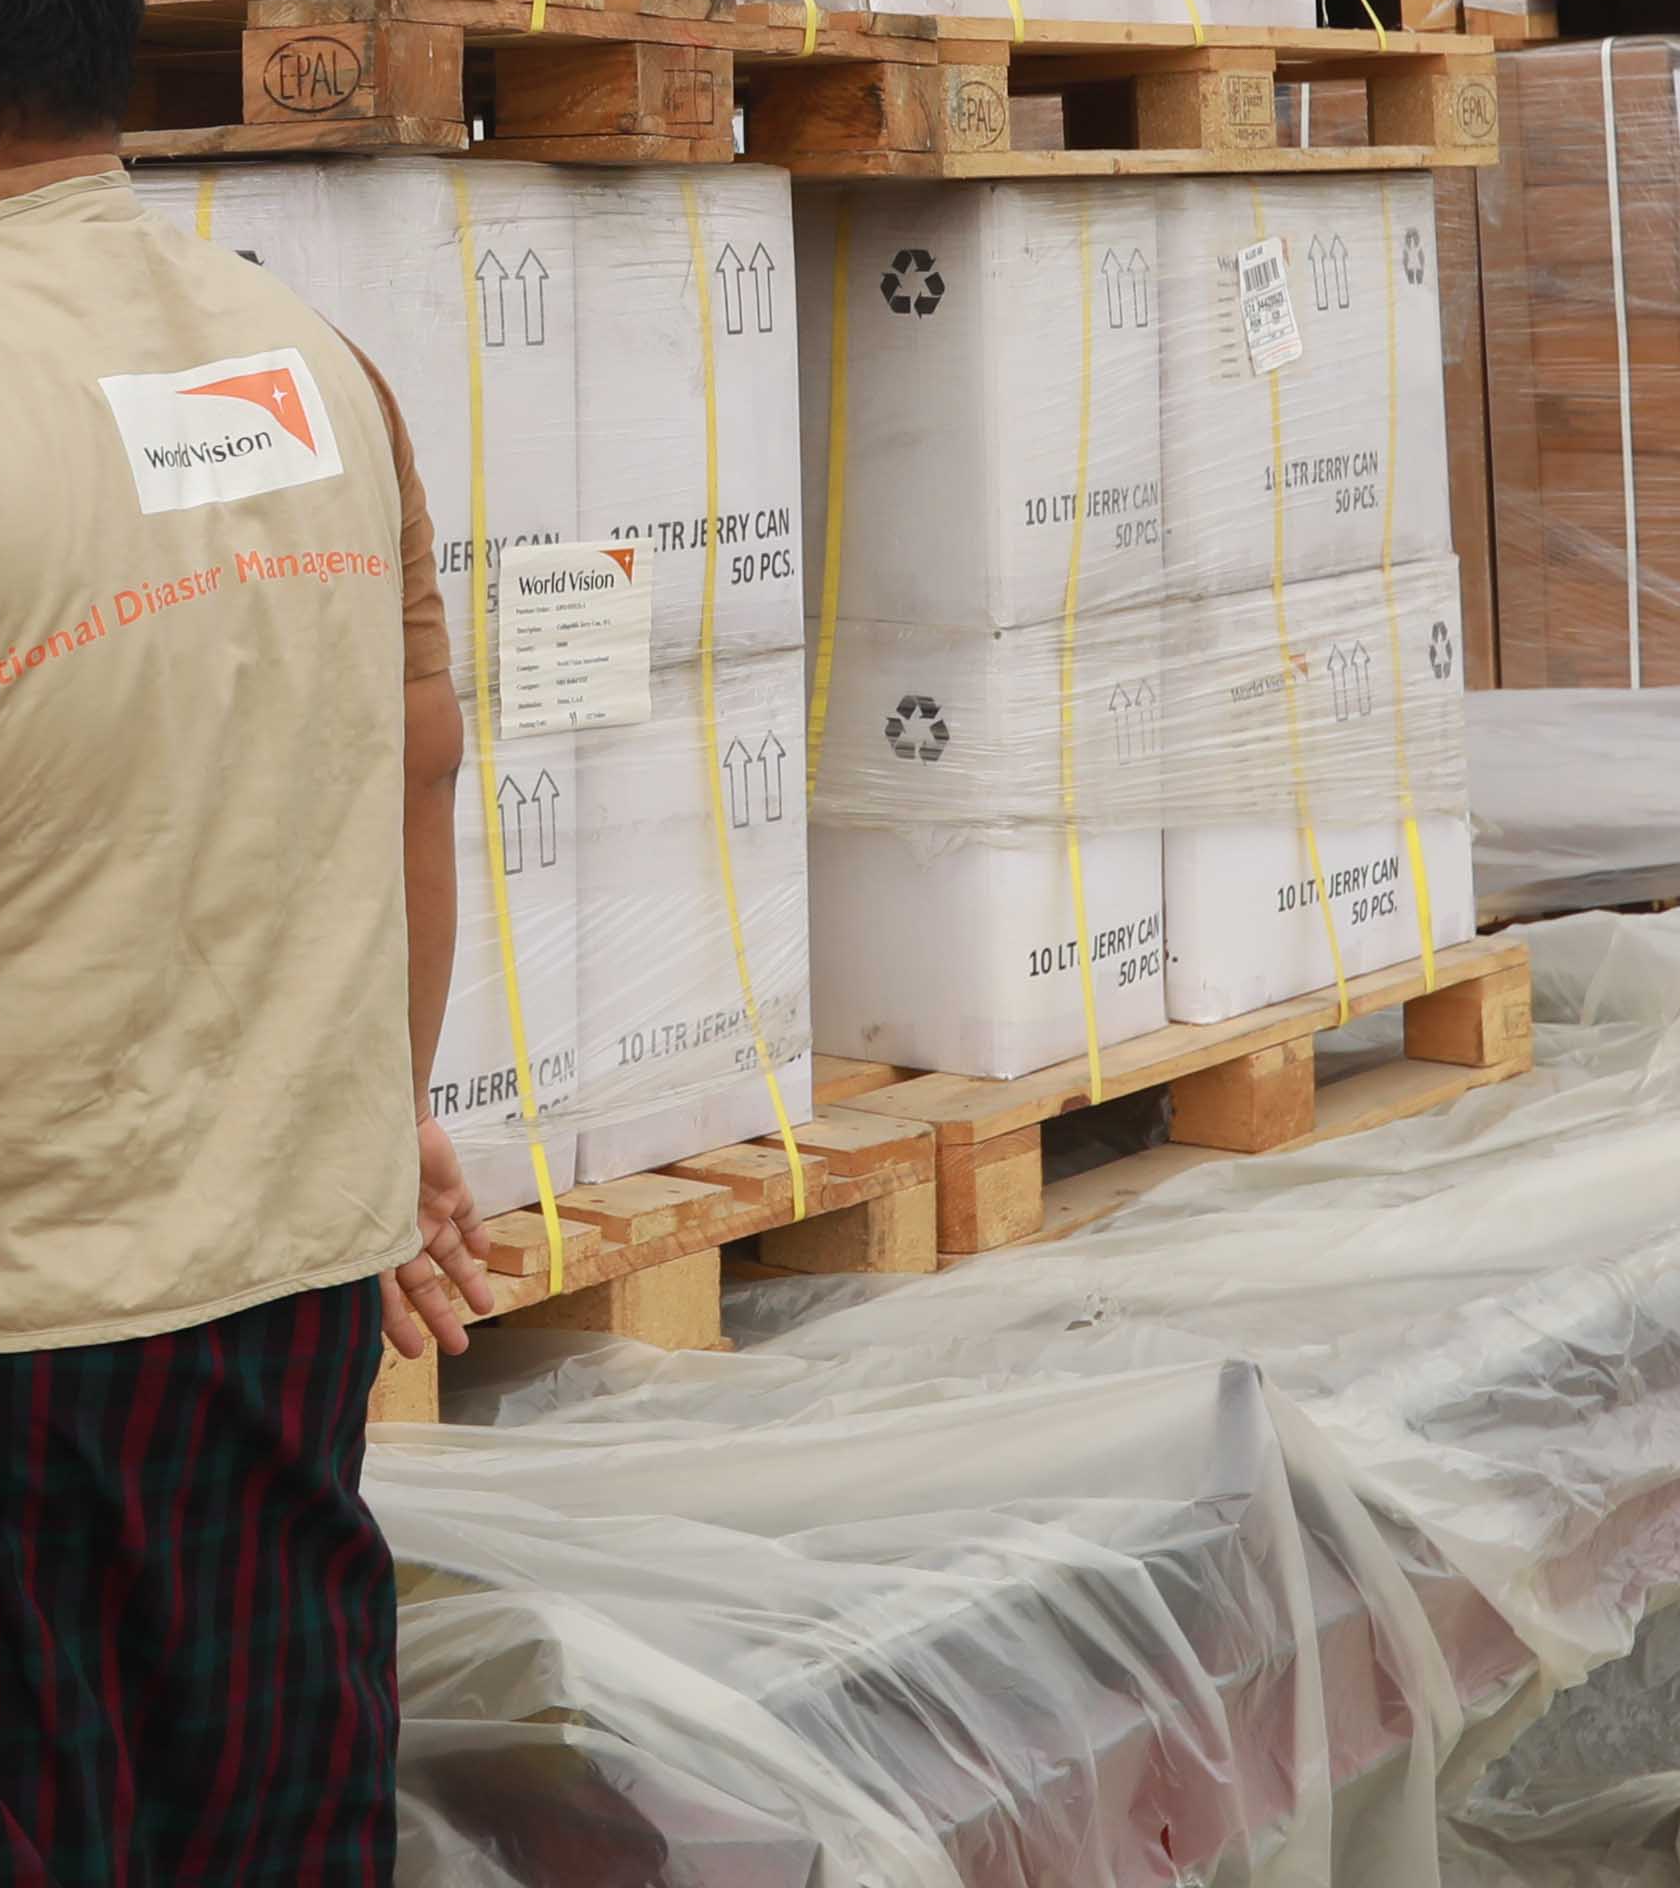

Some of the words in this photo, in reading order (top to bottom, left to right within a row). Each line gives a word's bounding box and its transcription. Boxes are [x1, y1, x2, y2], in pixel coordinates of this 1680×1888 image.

[280, 50, 344, 99] EPAL
[1461, 99, 1488, 126] EPAL
[144, 443, 193, 469] World
[191, 430, 273, 464] Vision
[1284, 462, 1310, 487] LTR
[1312, 456, 1349, 484] JERRY
[1353, 451, 1379, 476] CAN
[1024, 500, 1047, 526] 10
[1085, 487, 1128, 518] JERRY
[1335, 490, 1351, 513] 50
[1354, 487, 1378, 510] PCS.
[755, 508, 790, 540] CAN
[519, 570, 565, 596] World
[569, 570, 614, 591] Vision
[731, 556, 754, 585] 50
[760, 549, 795, 580] PCS.
[1278, 885, 1296, 913] 10
[1328, 866, 1367, 899] JERRY
[1372, 856, 1399, 887] CAN
[1352, 898, 1369, 924] 50
[1374, 891, 1398, 917] PCS.
[1029, 948, 1051, 976] 10
[1092, 923, 1135, 962] JERRY
[1136, 913, 1159, 943] CAN
[1118, 961, 1138, 987] 50
